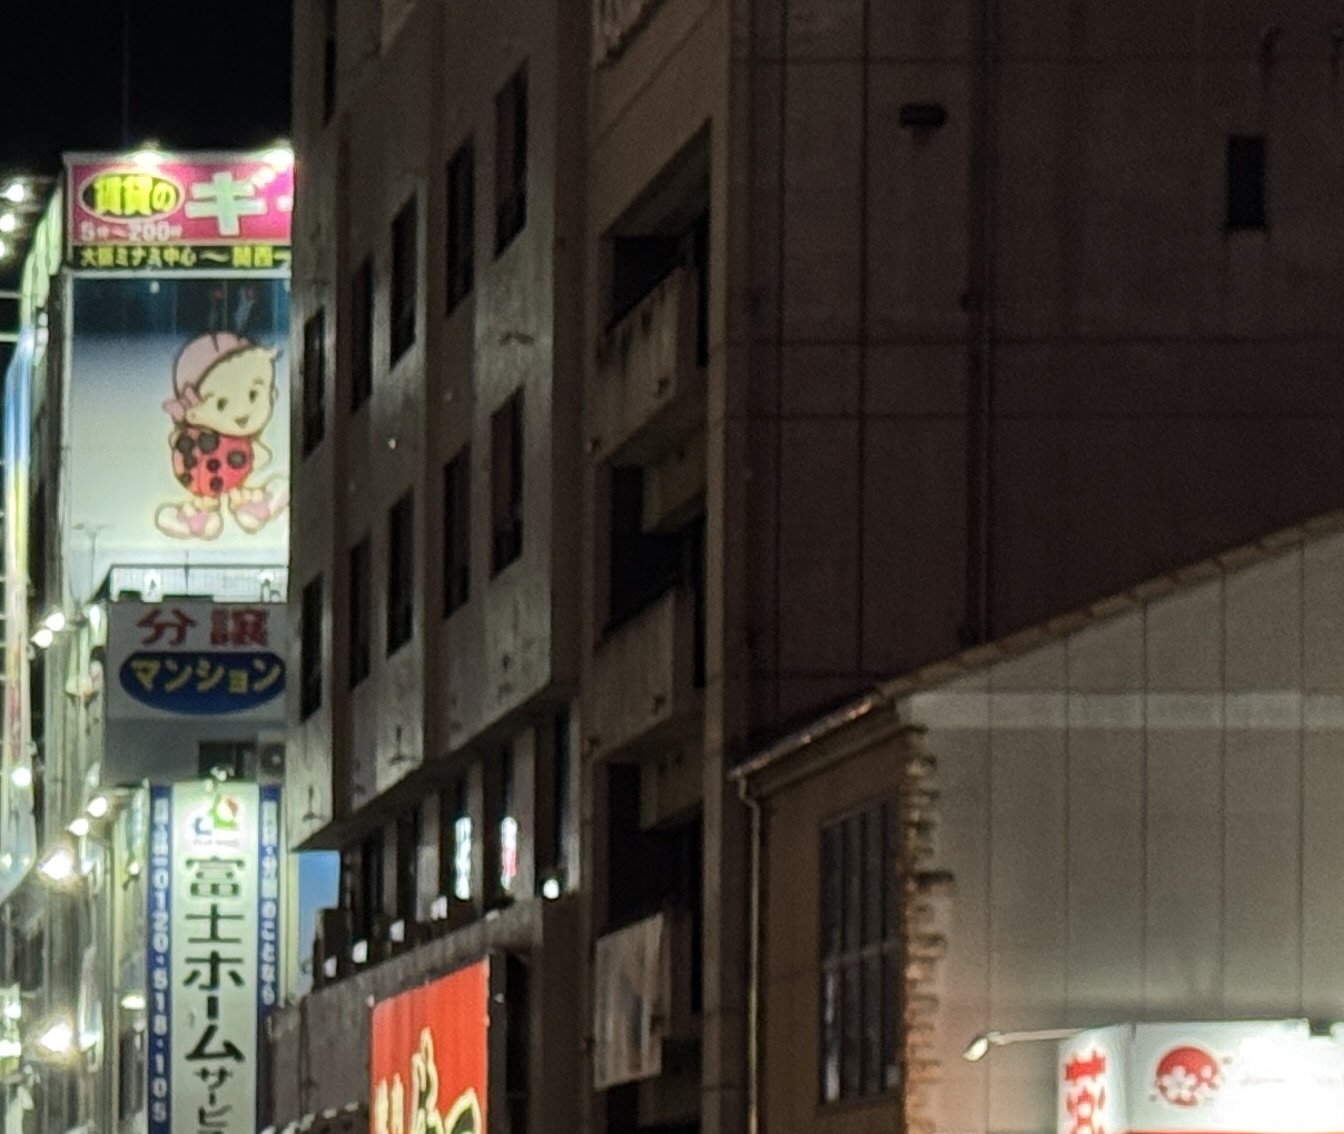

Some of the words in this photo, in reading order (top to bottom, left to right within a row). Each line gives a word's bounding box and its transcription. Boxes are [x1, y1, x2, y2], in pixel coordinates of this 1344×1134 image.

[129, 657, 282, 693] マンション
